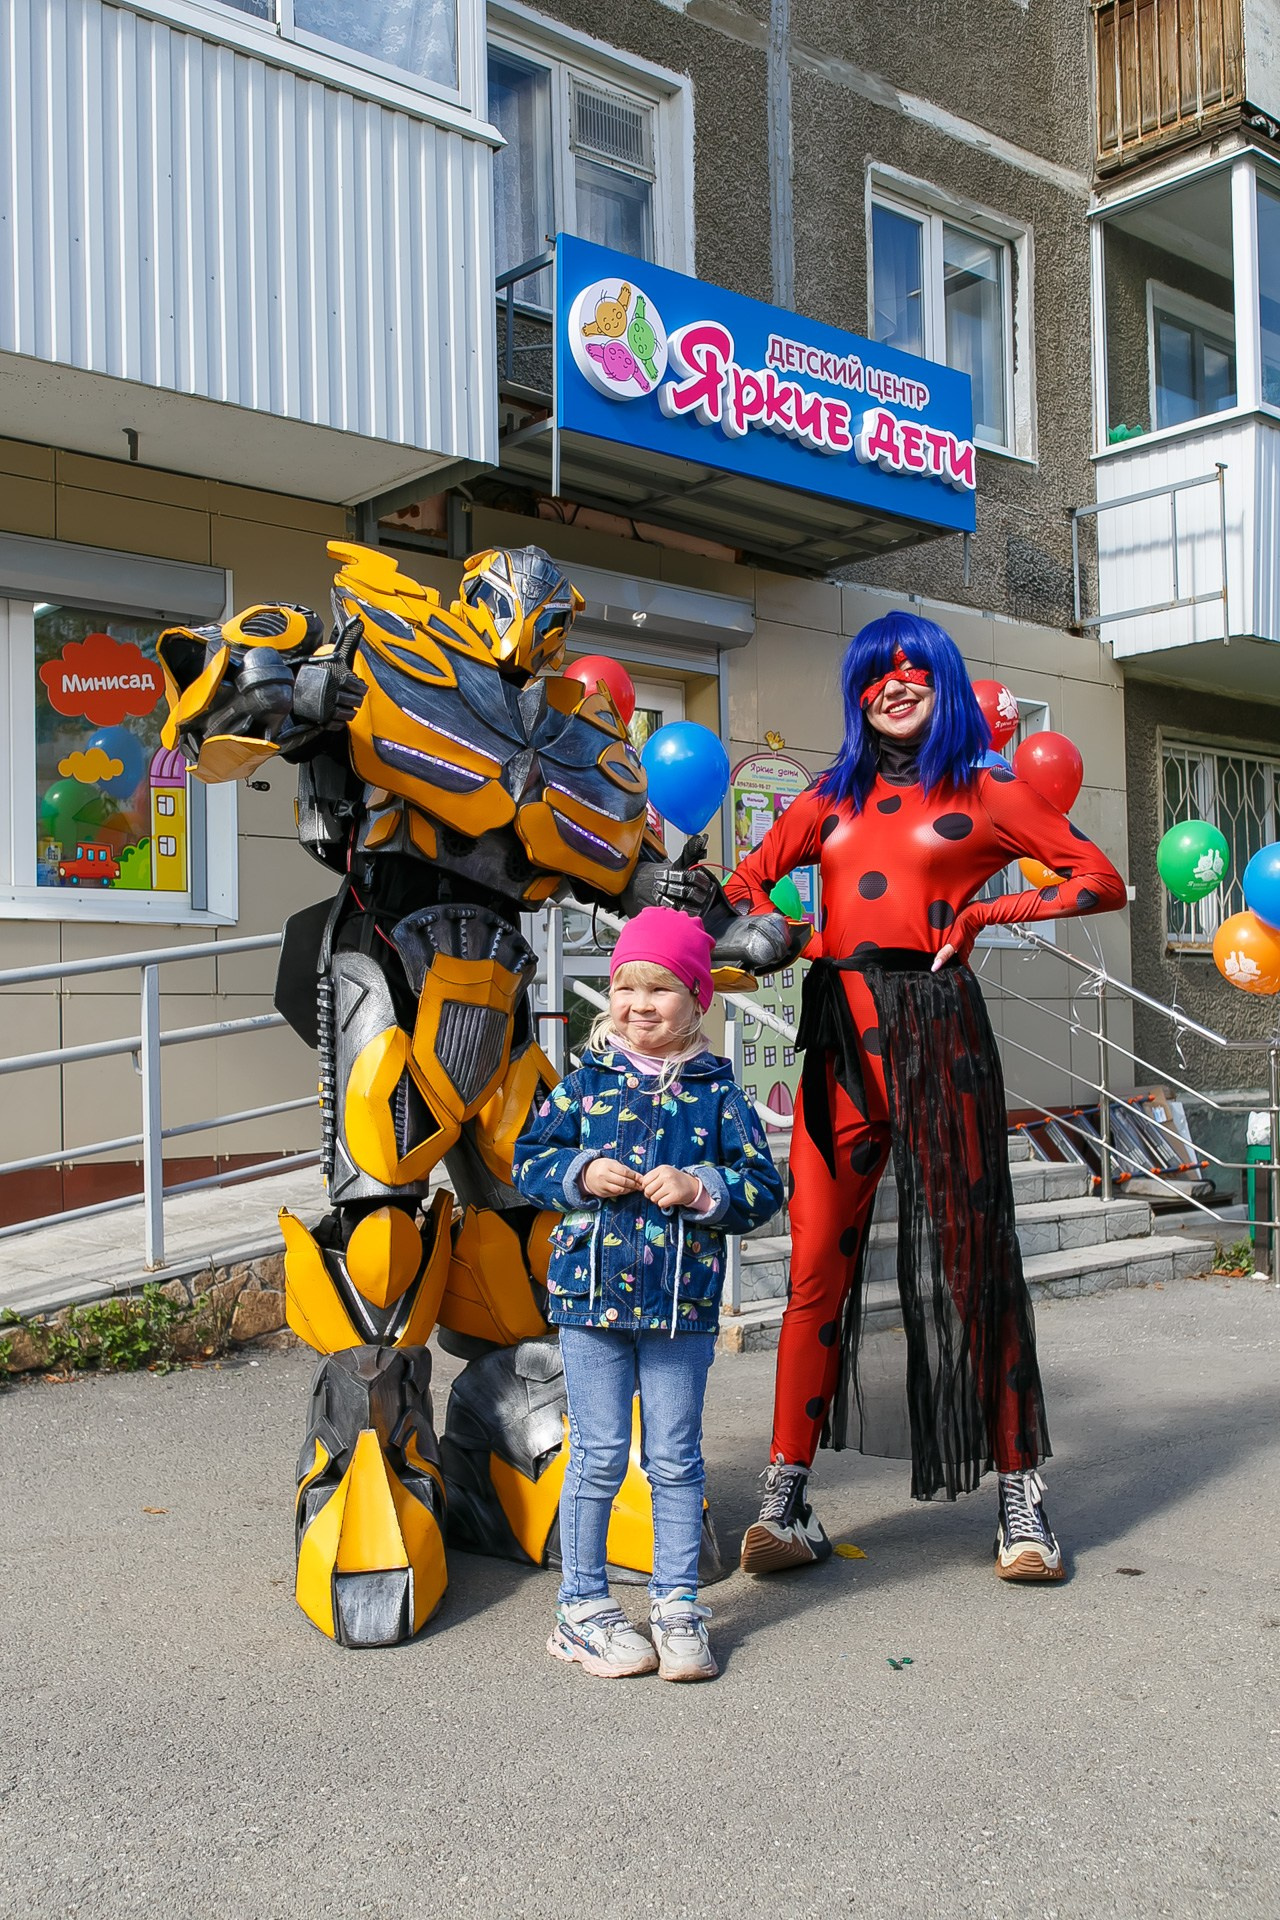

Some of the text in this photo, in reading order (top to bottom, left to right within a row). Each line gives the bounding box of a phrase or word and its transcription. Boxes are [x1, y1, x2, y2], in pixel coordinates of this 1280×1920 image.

[768, 338, 928, 407] ДЕТСКИЙ ЦЕНТР
[62, 673, 155, 693] Минисад
[750, 763, 799, 778] Яркие дети
